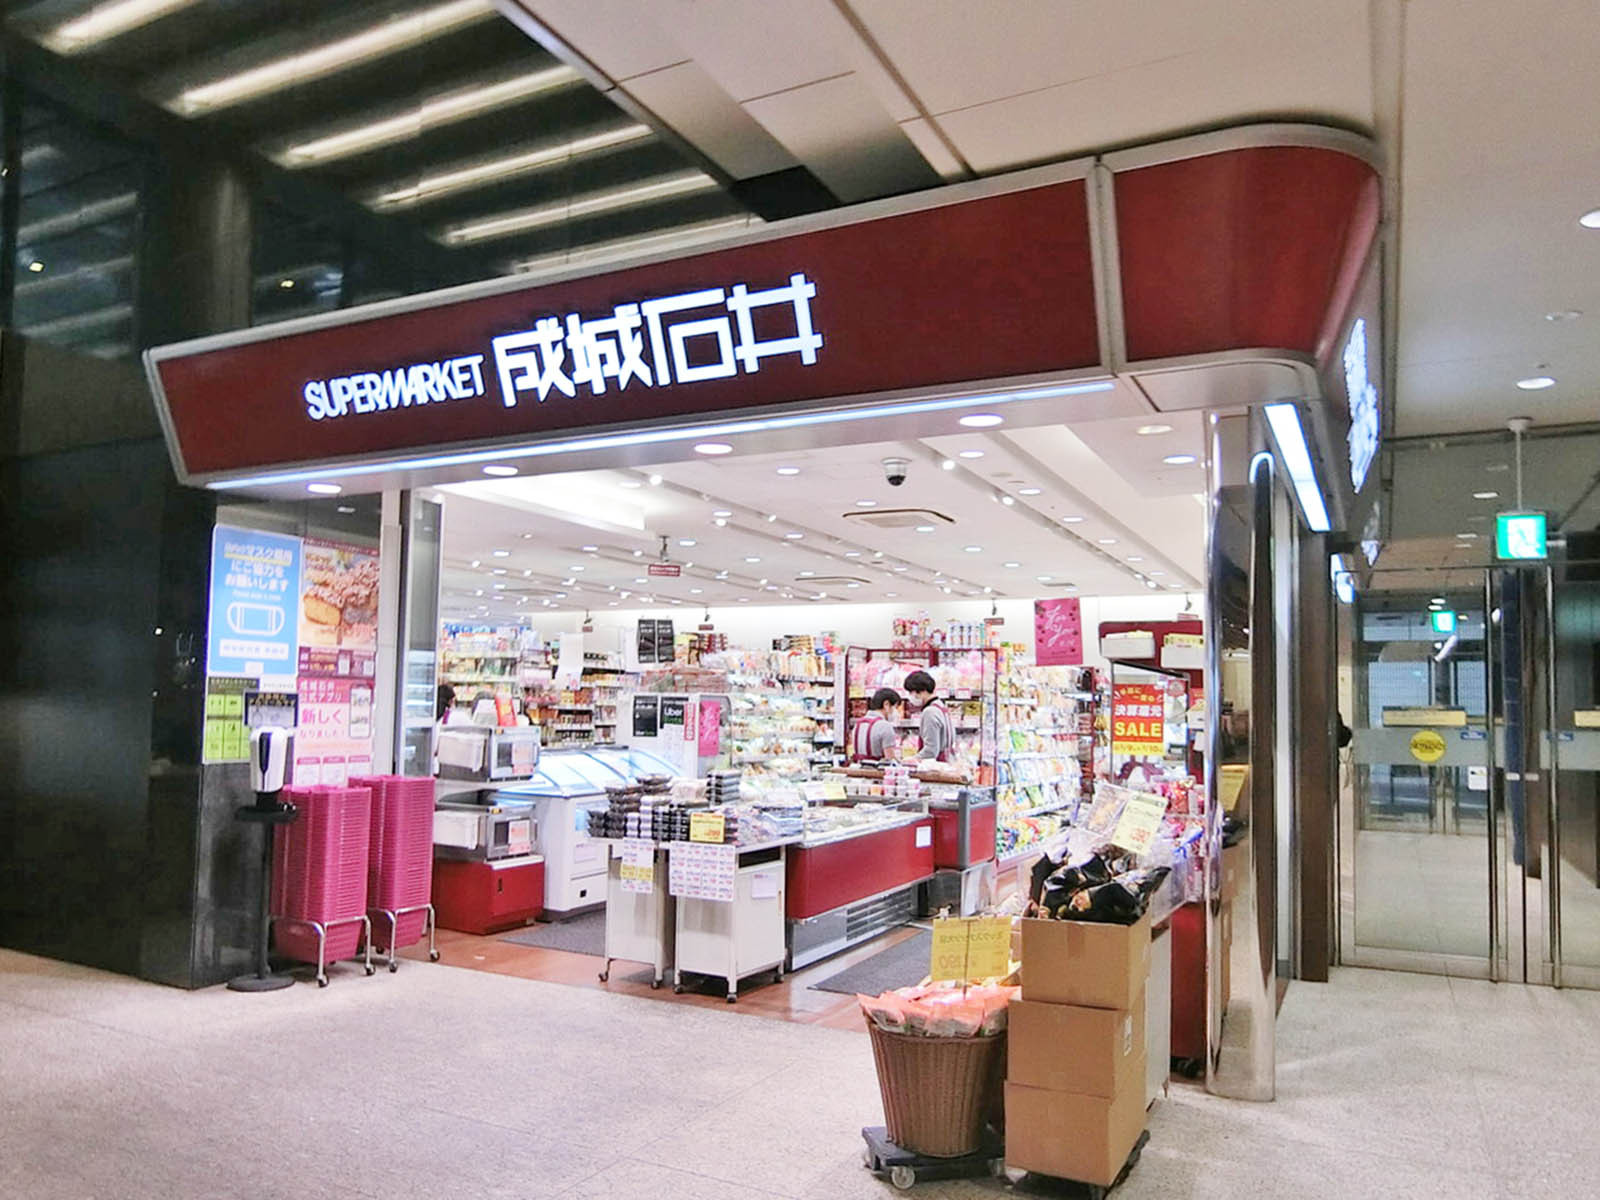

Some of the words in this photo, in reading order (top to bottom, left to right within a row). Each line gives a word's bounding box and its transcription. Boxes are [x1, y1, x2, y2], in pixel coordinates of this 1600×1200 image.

[304, 354, 485, 421] SUPERMARKET
[492, 273, 824, 407] 成城石井
[1114, 721, 1162, 737] SALE
